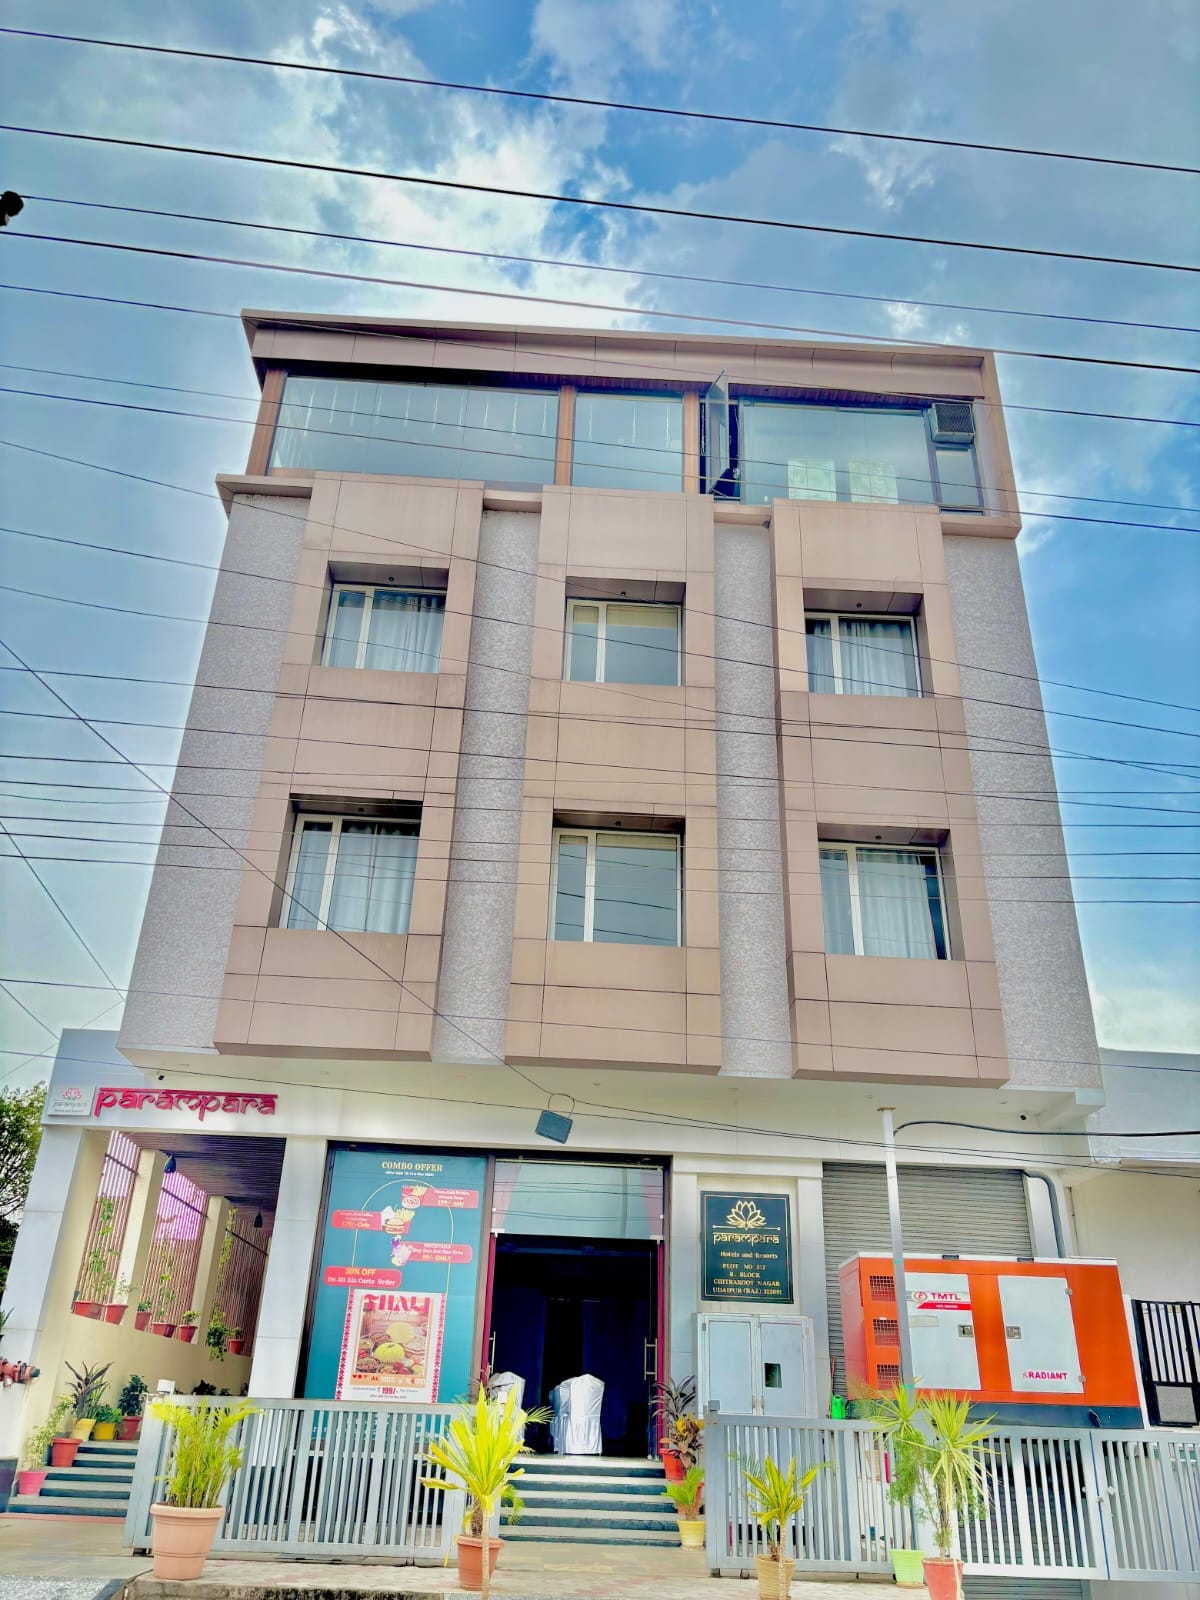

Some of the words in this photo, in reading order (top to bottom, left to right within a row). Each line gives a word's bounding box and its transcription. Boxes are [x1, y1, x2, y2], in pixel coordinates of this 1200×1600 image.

[94, 1087, 279, 1121] parampara
[381, 1161, 413, 1170] COMBO
[415, 1163, 443, 1172] OFFER
[712, 1231, 780, 1247] parampara
[930, 1292, 961, 1301] TMTL
[1028, 1371, 1068, 1380] RADIANT
